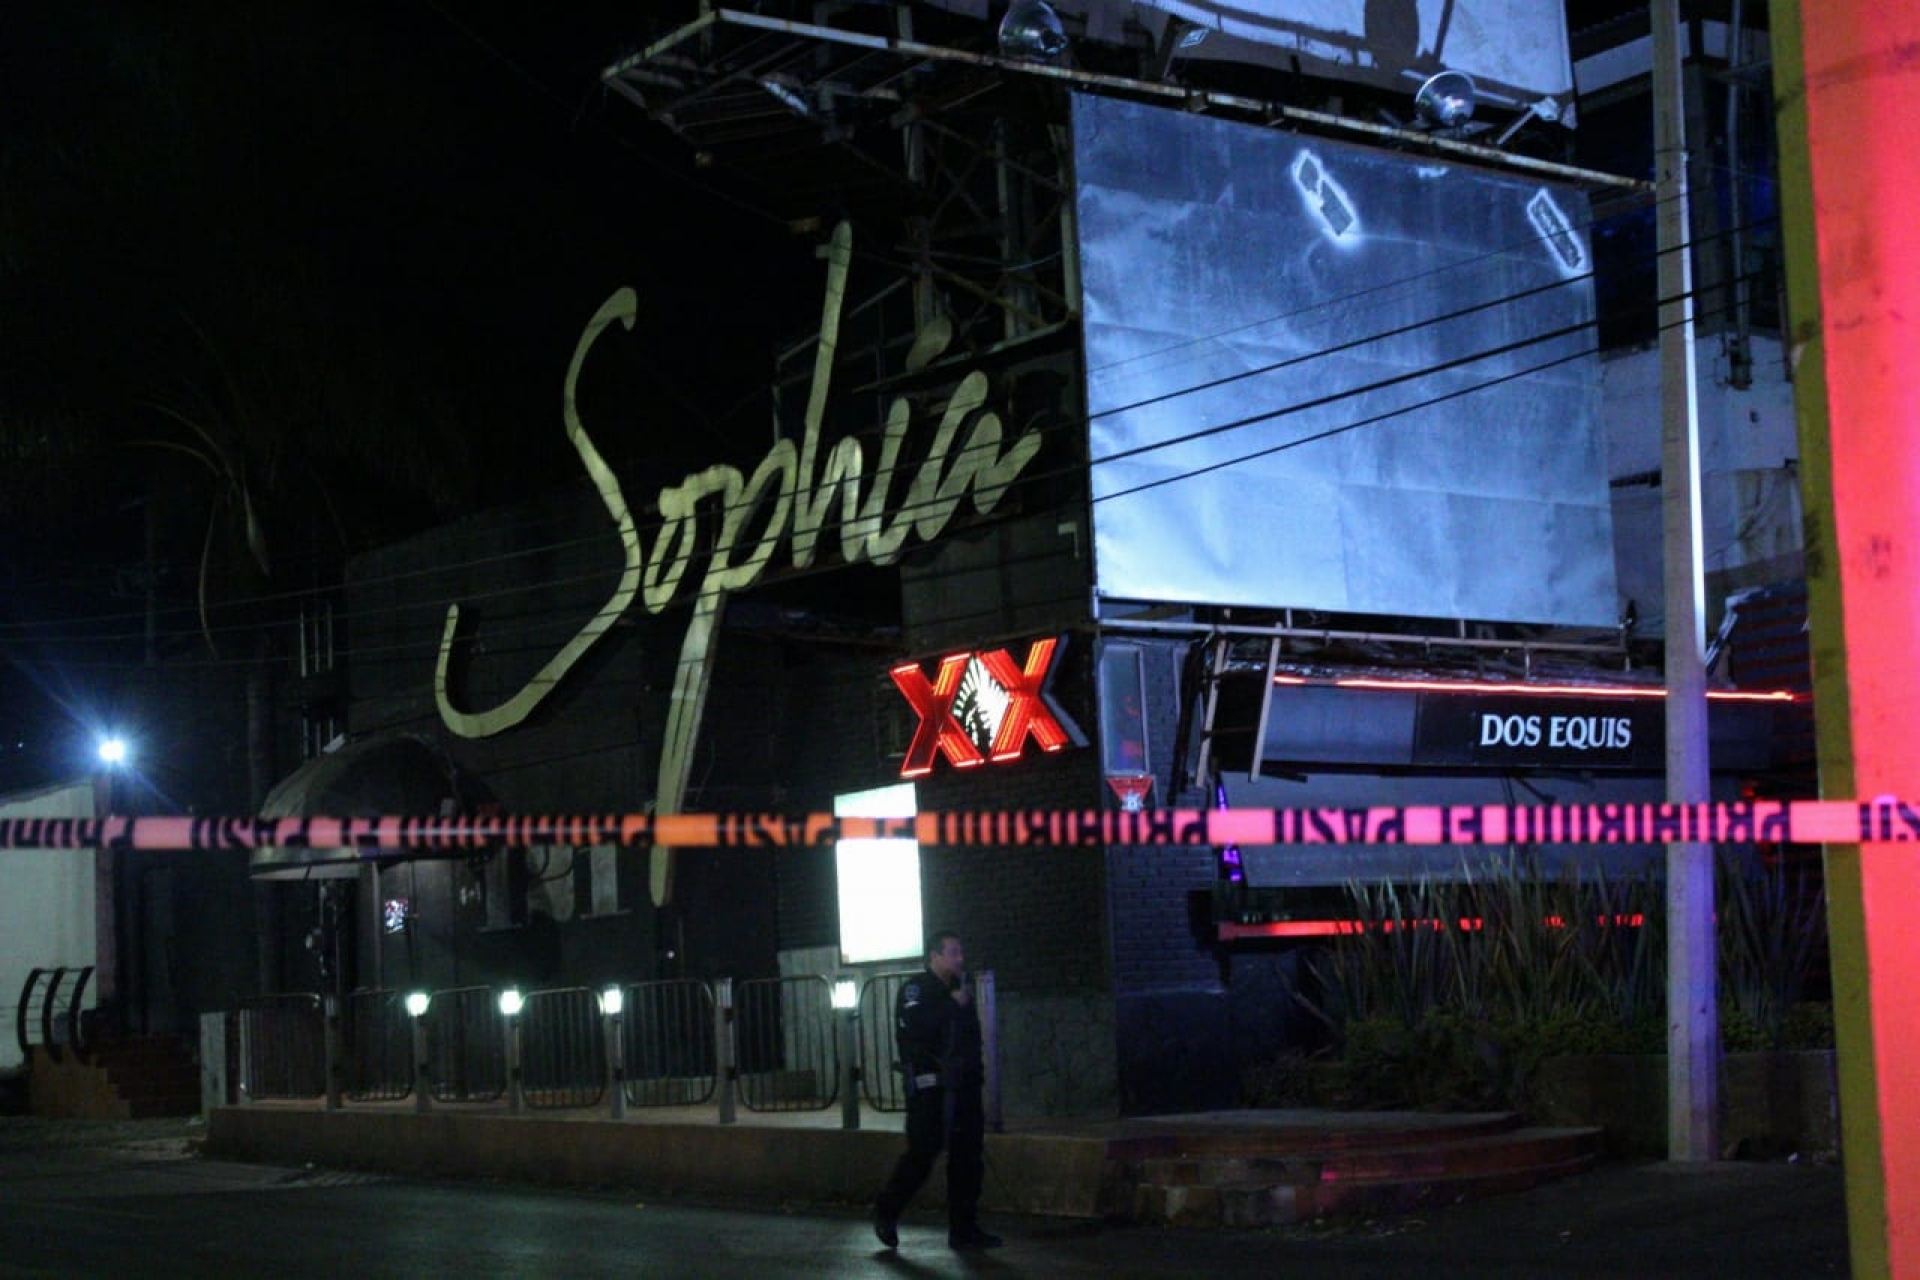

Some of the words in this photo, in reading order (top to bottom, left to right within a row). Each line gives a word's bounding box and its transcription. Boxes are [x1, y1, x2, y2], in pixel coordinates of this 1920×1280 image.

[435, 220, 1042, 906] Sophia
[1479, 713, 1542, 747] DOS
[1548, 715, 1633, 749] EQUIS
